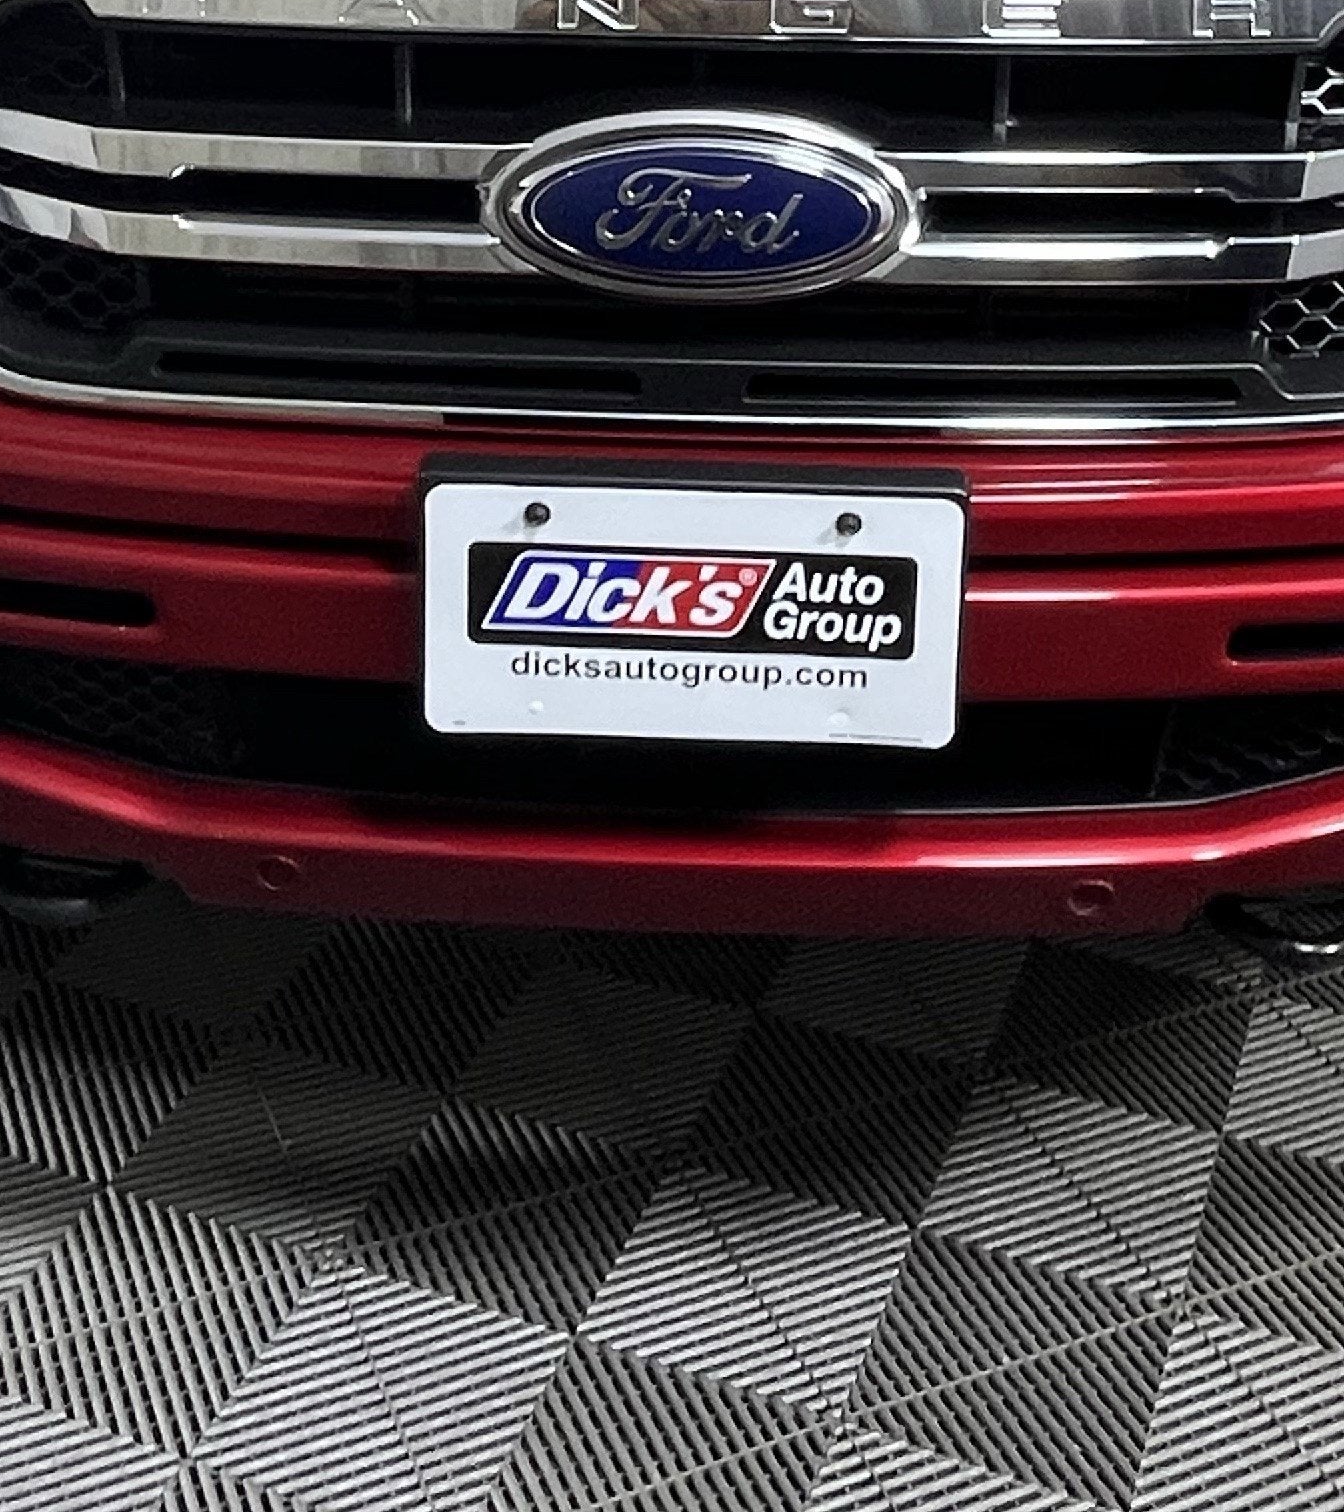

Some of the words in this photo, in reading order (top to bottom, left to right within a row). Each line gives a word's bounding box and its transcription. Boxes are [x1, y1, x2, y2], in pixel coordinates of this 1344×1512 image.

[594, 166, 805, 255] Ford
[503, 561, 746, 627] Dick's
[772, 561, 886, 606] Auto
[763, 600, 903, 651] Group
[511, 651, 868, 691] dicksautogroup.com
